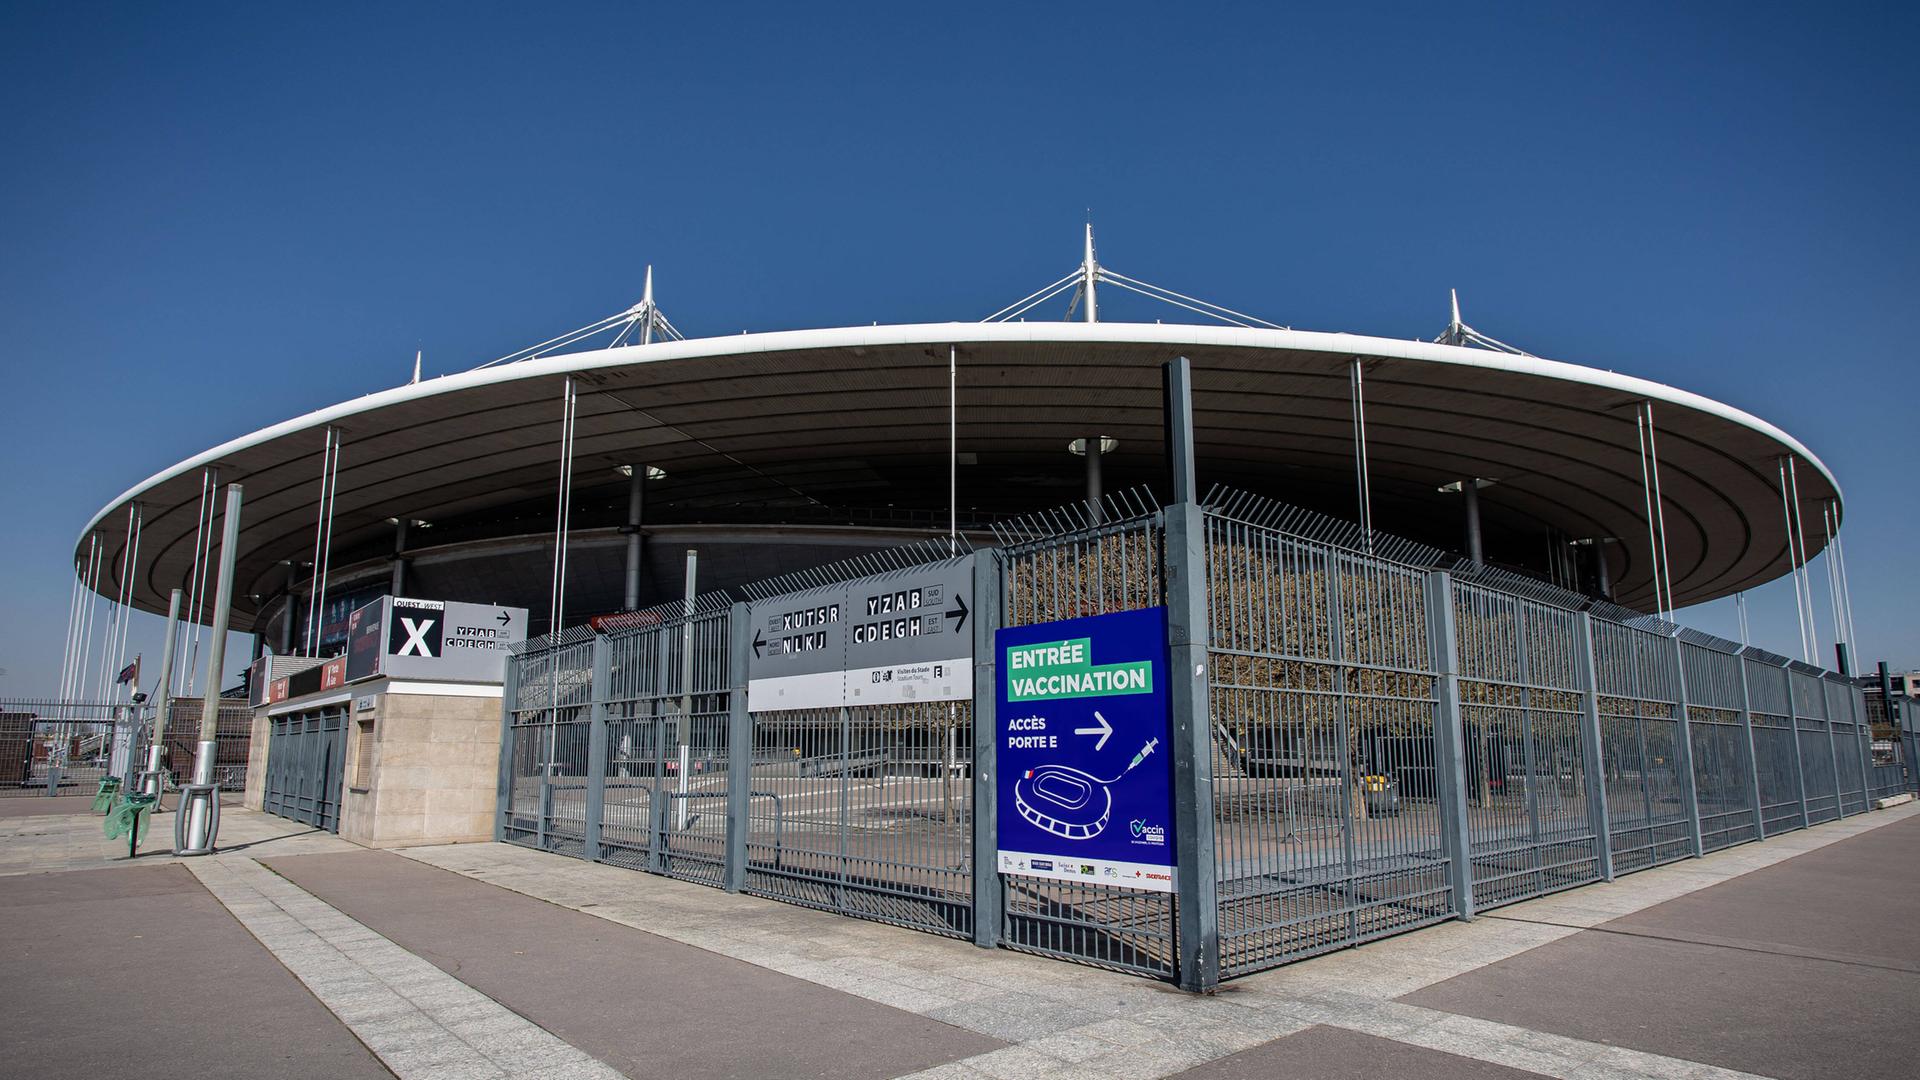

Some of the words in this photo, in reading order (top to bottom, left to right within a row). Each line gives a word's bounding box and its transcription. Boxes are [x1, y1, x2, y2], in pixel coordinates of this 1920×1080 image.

[869, 592, 920, 616] YZAB
[784, 607, 838, 631] XUTSR
[928, 617, 938, 625] EST
[396, 617, 435, 658] X
[458, 627, 495, 638] YZAB
[854, 619, 920, 644] CDEGH
[446, 639, 495, 650] CDEGH
[783, 634, 825, 654] NLKJ
[1011, 641, 1084, 669] ENTRÉE
[935, 668, 942, 678] E
[1012, 668, 1146, 697] VACCINATION
[1008, 714, 1046, 731] ACCÈS
[1008, 736, 1047, 749] PORTE
[1049, 736, 1057, 748] E
